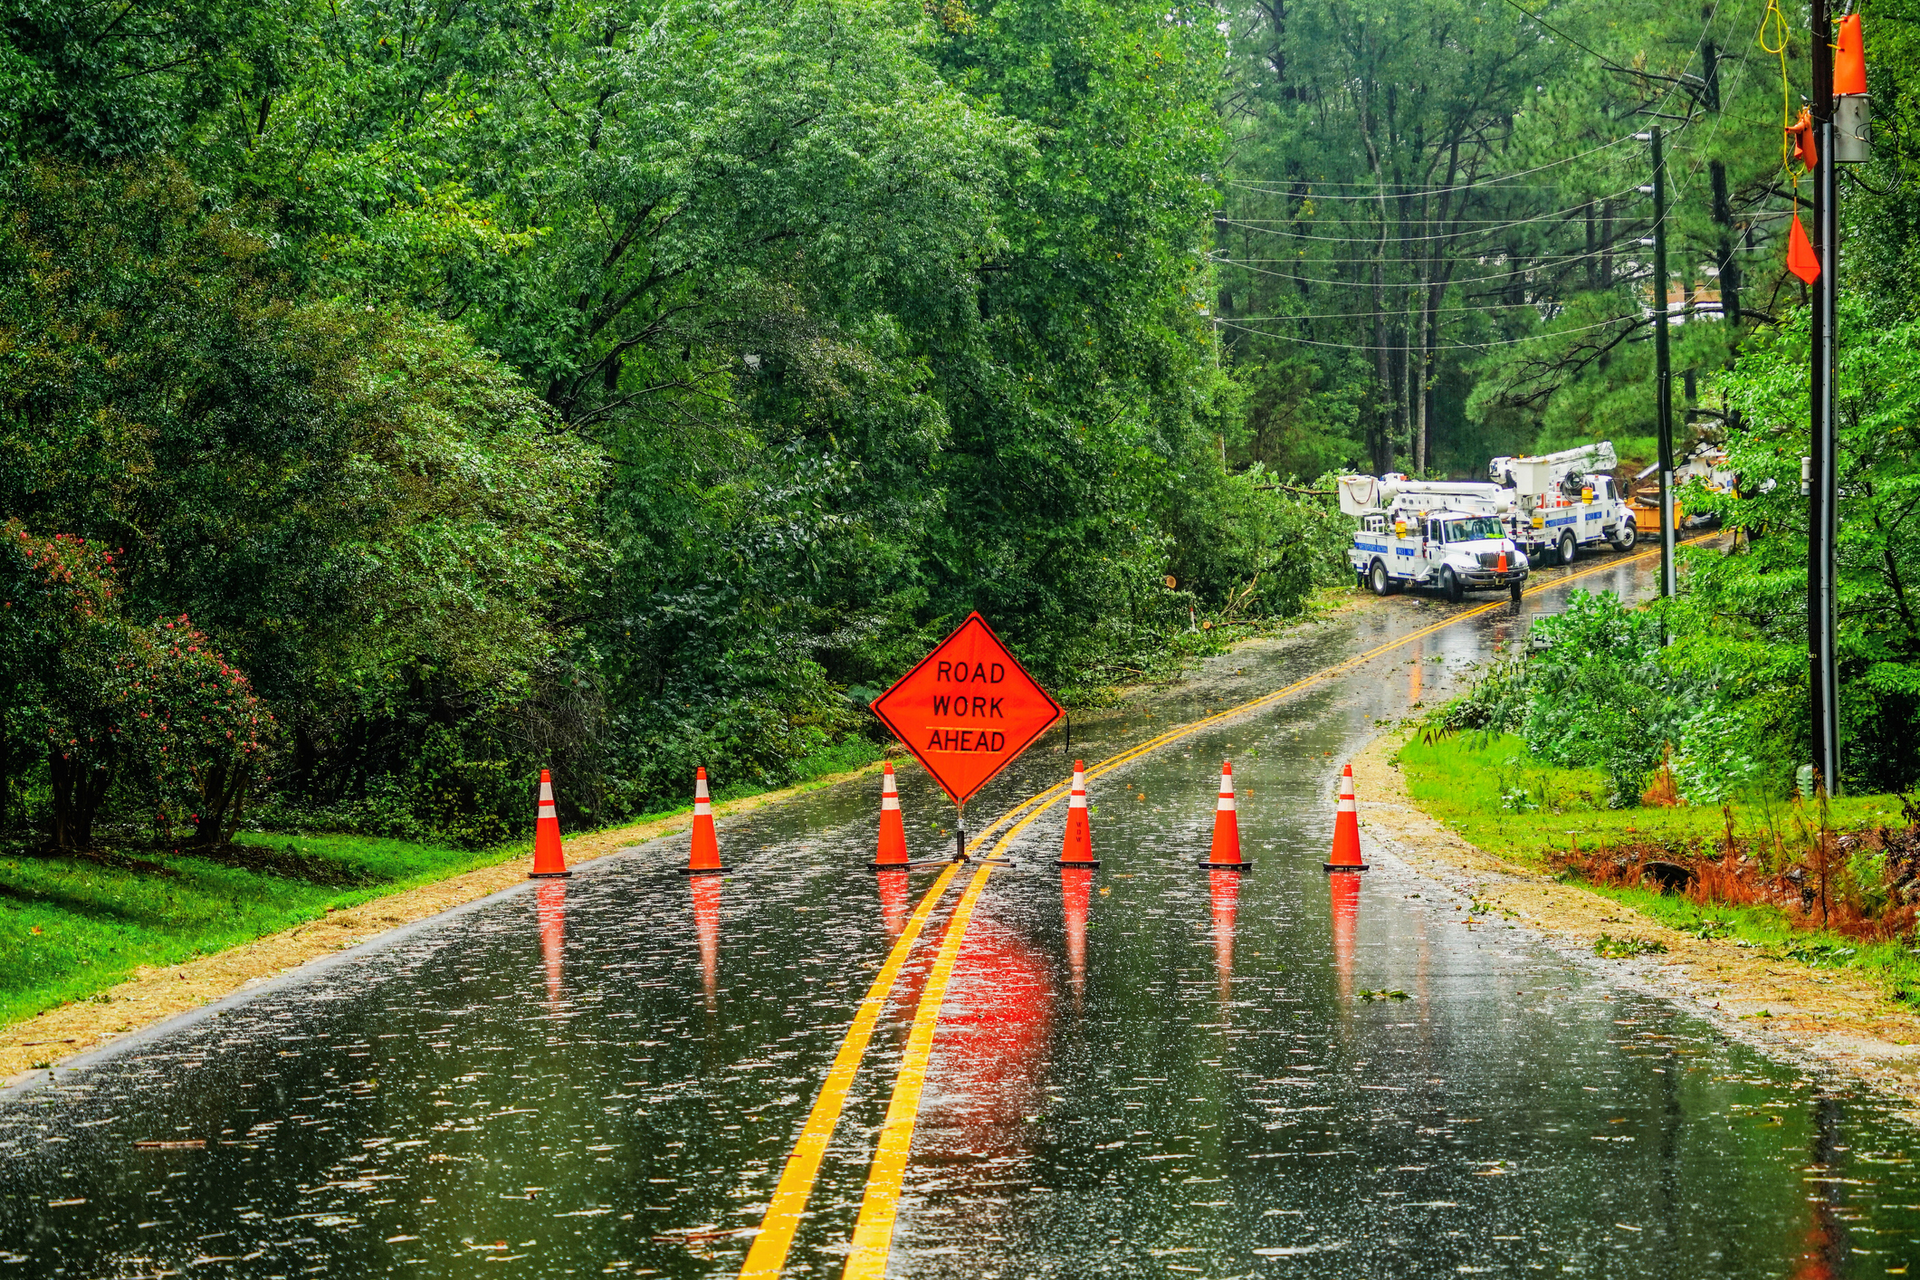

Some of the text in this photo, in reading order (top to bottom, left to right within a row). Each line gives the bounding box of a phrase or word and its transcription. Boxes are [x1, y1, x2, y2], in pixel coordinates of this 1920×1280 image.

[937, 661, 1005, 684] ROAD
[933, 695, 1005, 719] WORK
[927, 729, 1005, 752] AHEAD
